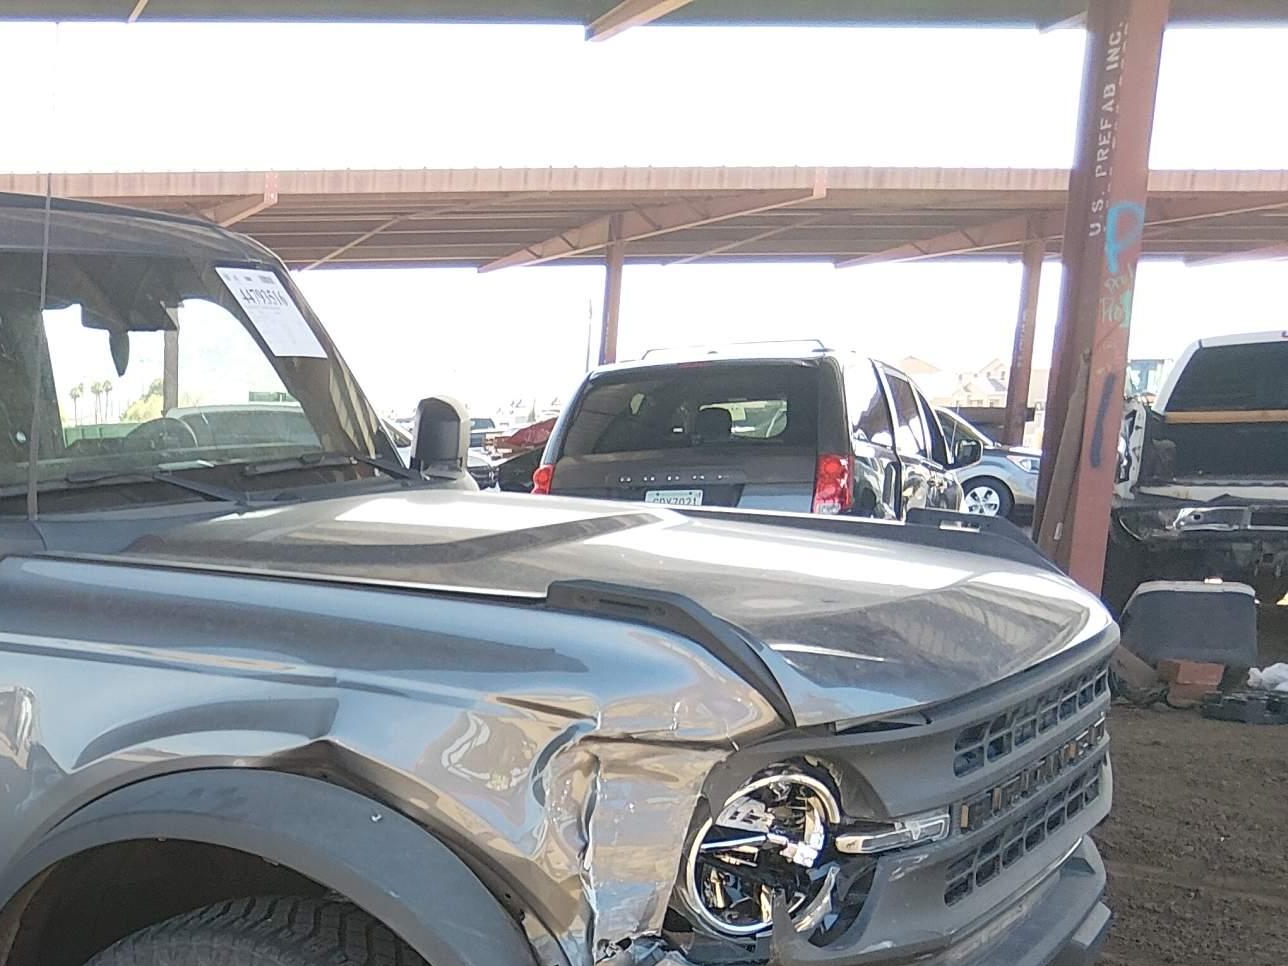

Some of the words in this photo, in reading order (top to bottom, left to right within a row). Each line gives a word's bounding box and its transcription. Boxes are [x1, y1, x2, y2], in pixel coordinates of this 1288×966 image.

[1106, 21, 1124, 71] INC.
[1096, 83, 1116, 178] PREFAB
[1089, 190, 1106, 236] U.S.
